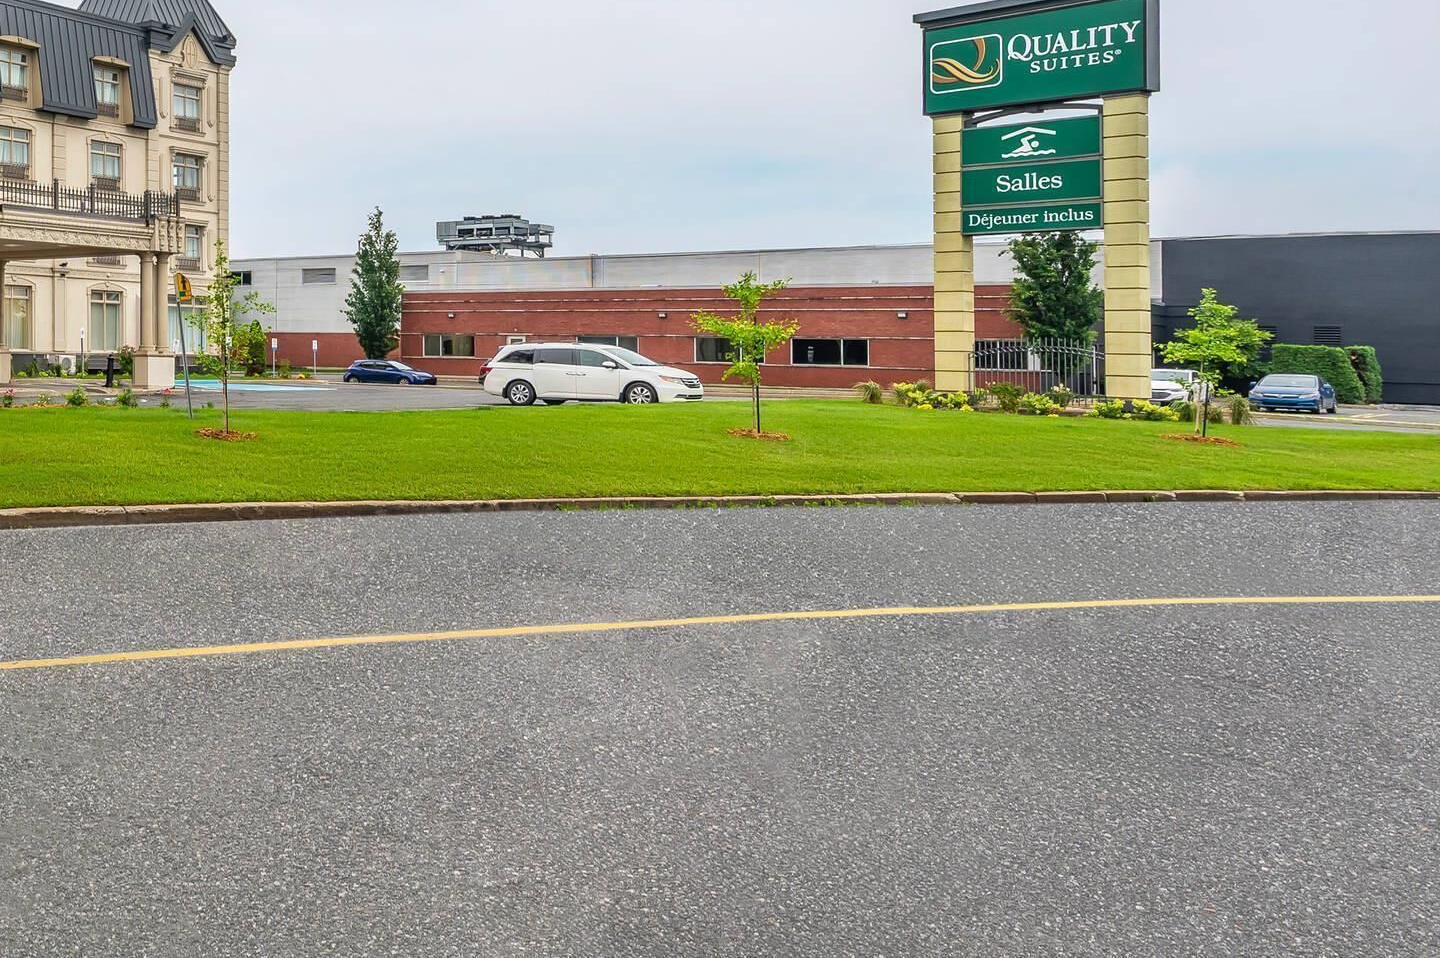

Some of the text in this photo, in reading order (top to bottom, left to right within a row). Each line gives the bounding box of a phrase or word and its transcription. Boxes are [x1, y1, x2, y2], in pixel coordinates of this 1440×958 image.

[1007, 19, 1141, 62] QUALITY
[996, 172, 1063, 193] Salles
[968, 208, 1094, 230] Déjeuner inclus
